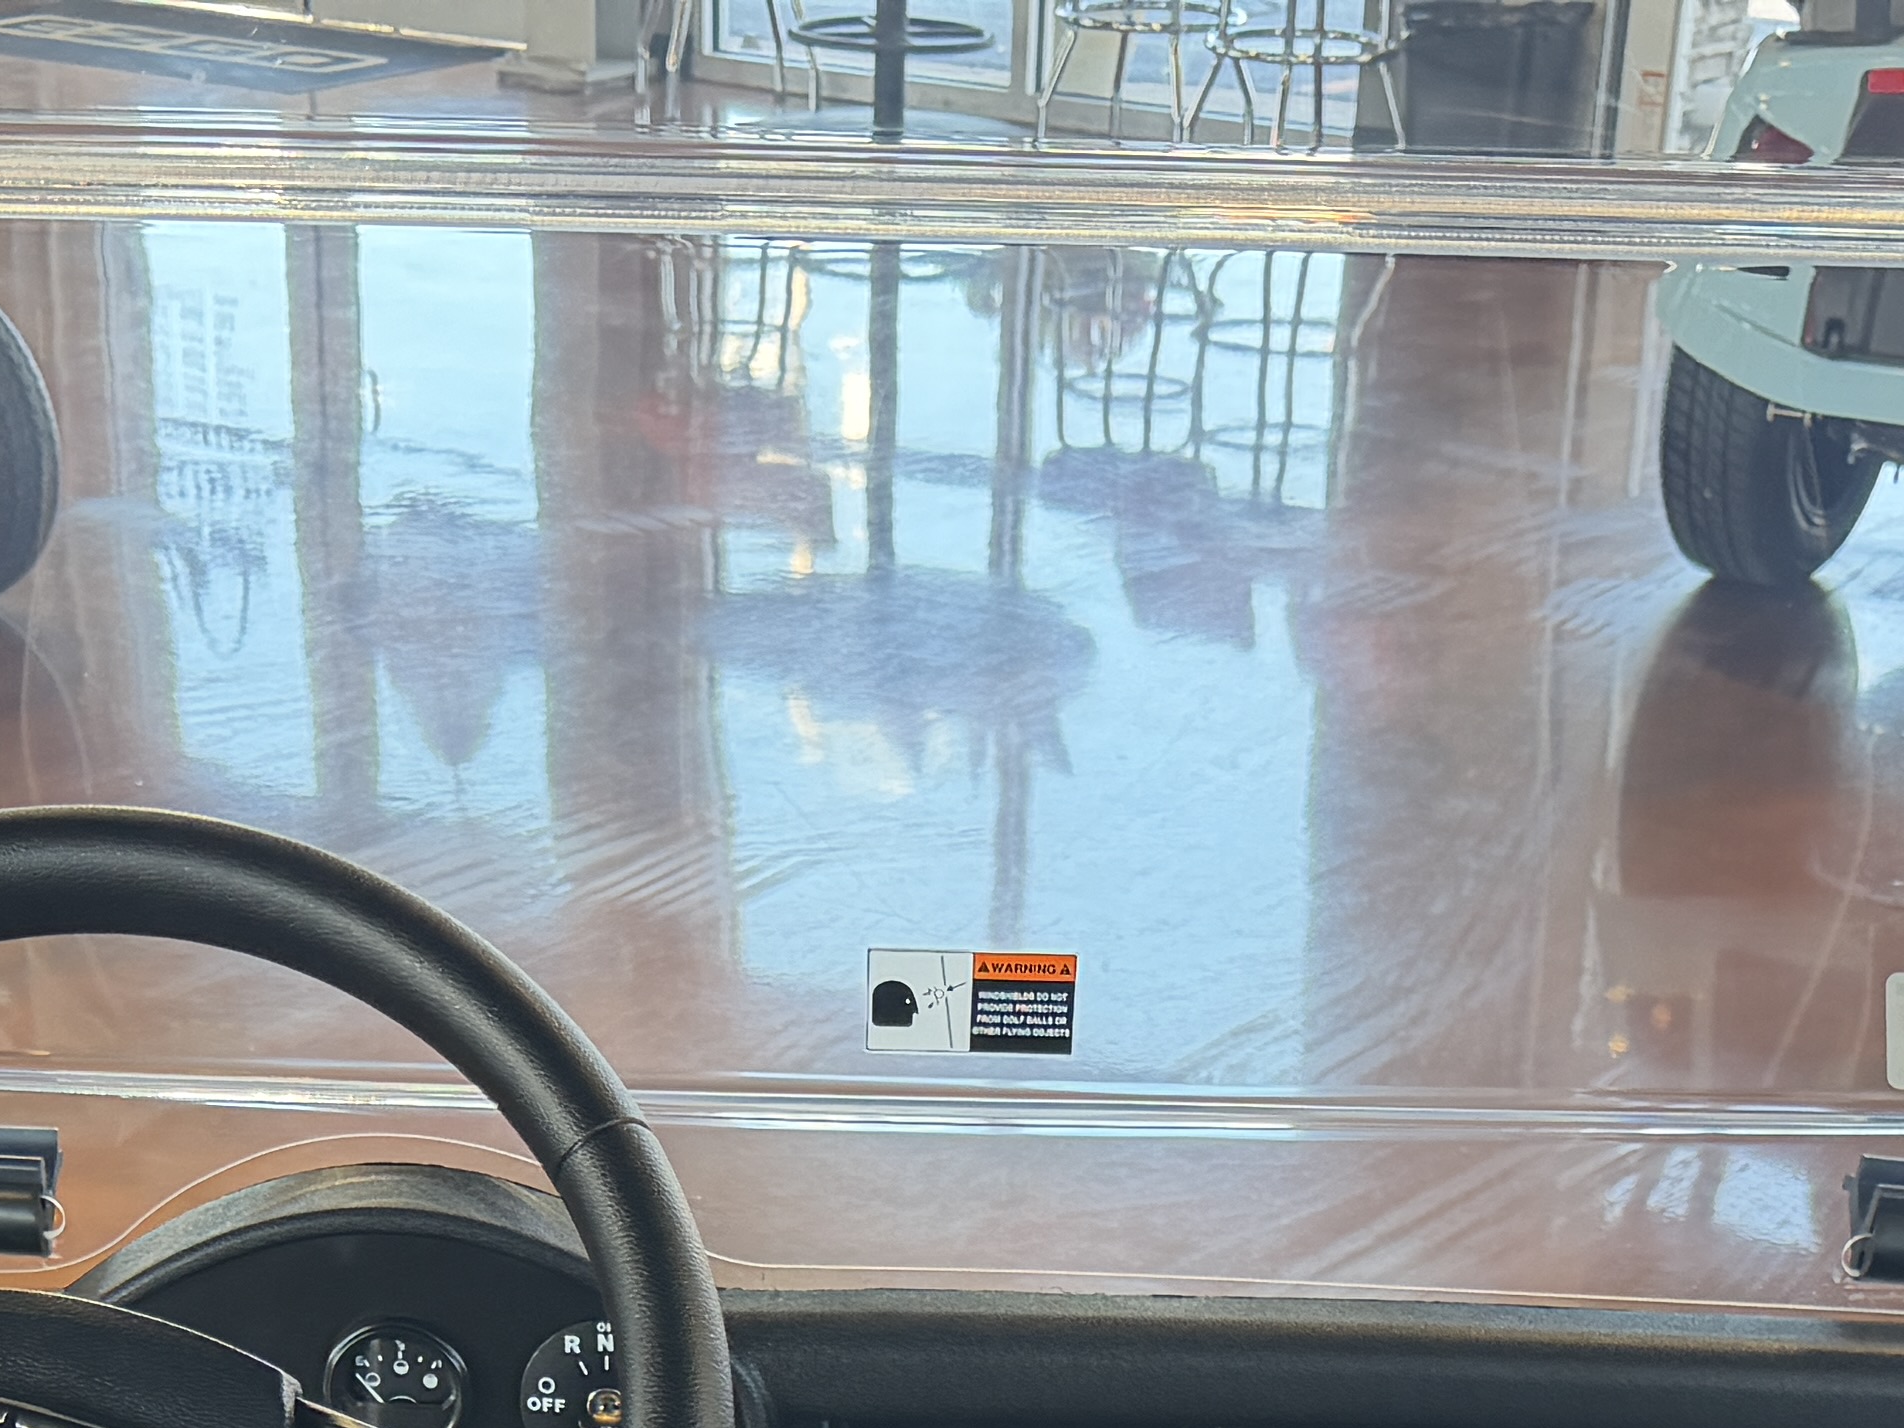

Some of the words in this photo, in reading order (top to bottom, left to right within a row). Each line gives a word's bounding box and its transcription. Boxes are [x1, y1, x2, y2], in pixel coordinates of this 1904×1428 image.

[991, 963, 1056, 974] WARNING
[564, 1335, 581, 1354] R
[597, 1333, 614, 1352] N
[527, 1396, 566, 1413] OFF
